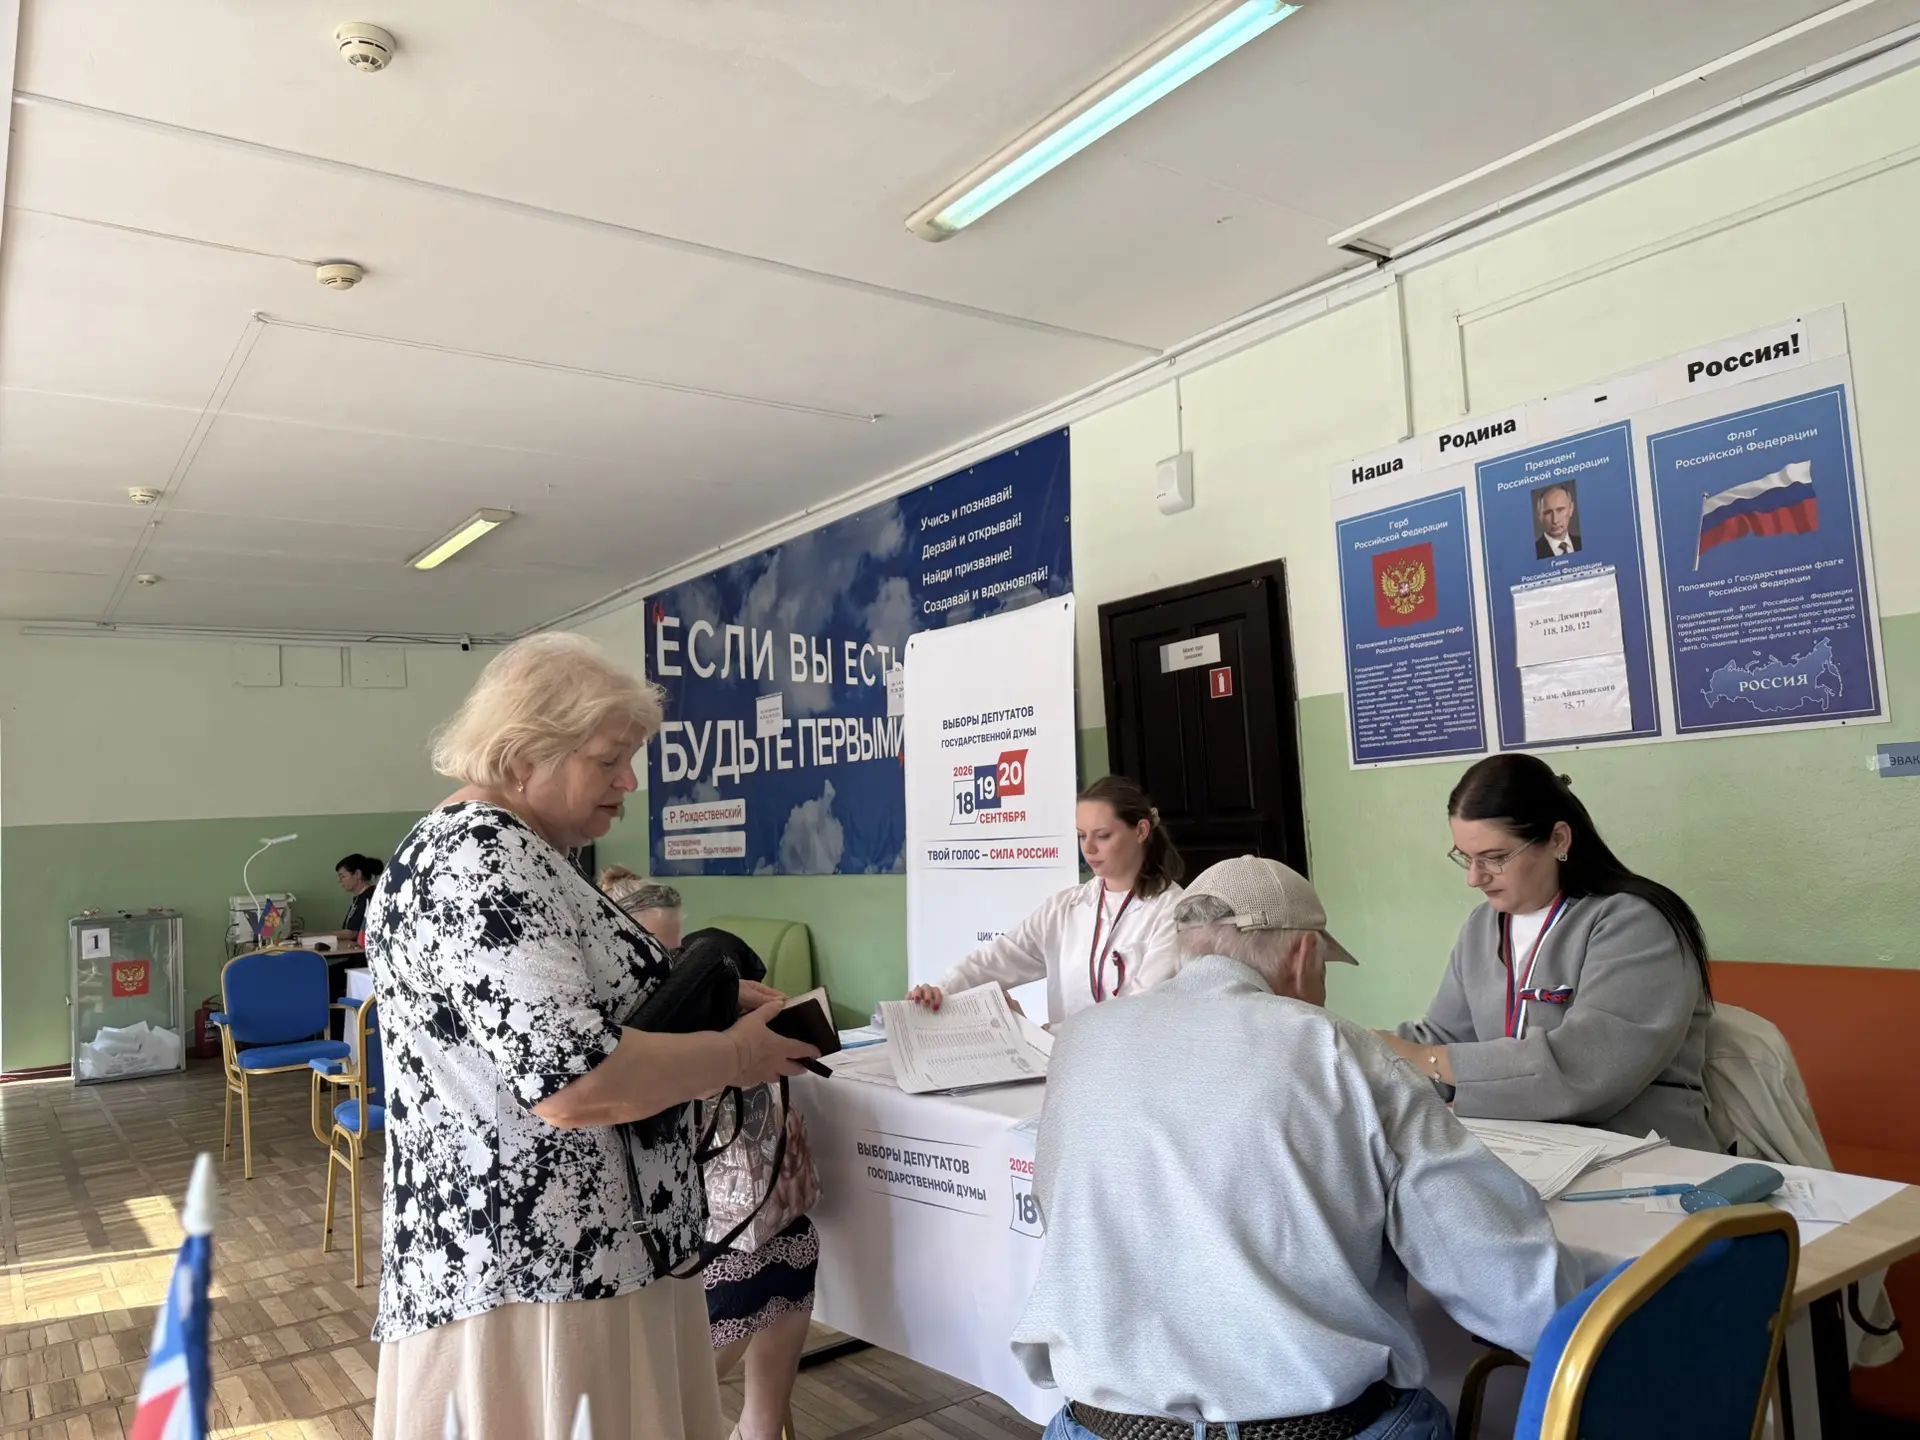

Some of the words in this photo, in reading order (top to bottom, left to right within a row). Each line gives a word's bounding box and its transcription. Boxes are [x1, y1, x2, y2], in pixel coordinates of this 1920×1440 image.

[1351, 455, 1403, 484] Наша
[1438, 418, 1516, 453] Родина
[1687, 333, 1800, 382] Россия!
[1727, 428, 1758, 442] Флаг
[1675, 445, 1743, 470] Российской
[1746, 427, 1818, 452] Федерации
[1525, 451, 1576, 472] Президент
[1497, 470, 1551, 492] Российской
[1553, 456, 1610, 477] Федерации
[920, 512, 950, 531] Учись
[951, 509, 958, 519] и
[960, 484, 1013, 517] познавай!
[922, 535, 957, 560] Дерзай
[959, 535, 966, 545] и
[967, 512, 1022, 543] открывай!
[1354, 532, 1400, 550] Российской
[1401, 520, 1448, 538] Федерации
[1389, 518, 1409, 530] Герб
[922, 566, 952, 586] Найди
[955, 545, 1013, 578] призвание!
[1522, 569, 1561, 583] Российской
[1678, 579, 1725, 593] Положение
[1734, 564, 1812, 584] Государственном
[1814, 557, 1844, 570] флаге
[923, 589, 970, 614] Создавай
[972, 588, 979, 600] и
[981, 565, 1048, 599] вдохновляй!
[1708, 582, 1758, 598] Российской
[1760, 574, 1811, 589] Федерации
[1557, 607, 1602, 622] Димитрова
[1577, 621, 1590, 630] 122
[656, 616, 774, 681] ЕСЛИ
[789, 632, 833, 684] ВЫ
[1739, 674, 1808, 692] РОССИЯ
[943, 713, 979, 730] ВЫБОРЫ
[981, 705, 1034, 726] ДЕПУТАТОВ
[941, 728, 1011, 748] ГОСУДАРСТВЕННОЙ
[1013, 726, 1037, 740] ДУМЫ
[659, 719, 793, 787] БУДЬТЕ
[798, 717, 905, 768] ПЕРВЫМИ
[953, 765, 973, 777] 2026
[956, 792, 974, 815] 18
[976, 776, 996, 800] 19
[998, 761, 1023, 786] 20
[680, 804, 742, 824] Рождественский
[979, 810, 1026, 824] СЕНТЯБРЯ
[928, 847, 950, 861] ТВОЙ
[951, 849, 980, 861] ГОЛОС
[990, 848, 1015, 861] СИЛА
[1016, 847, 1058, 860] РОССИИ!
[92, 934, 100, 950] 1
[977, 931, 993, 942] ЦИК
[857, 1142, 901, 1163] ВЫБОРЫ
[903, 1150, 970, 1175] ДЕПУТАТОВ
[1009, 1158, 1035, 1174] 2026
[867, 1166, 955, 1194] ГОСУДАРСТВЕННОЙ
[956, 1186, 986, 1201] ДУМЫ
[1015, 1192, 1038, 1225] 18
